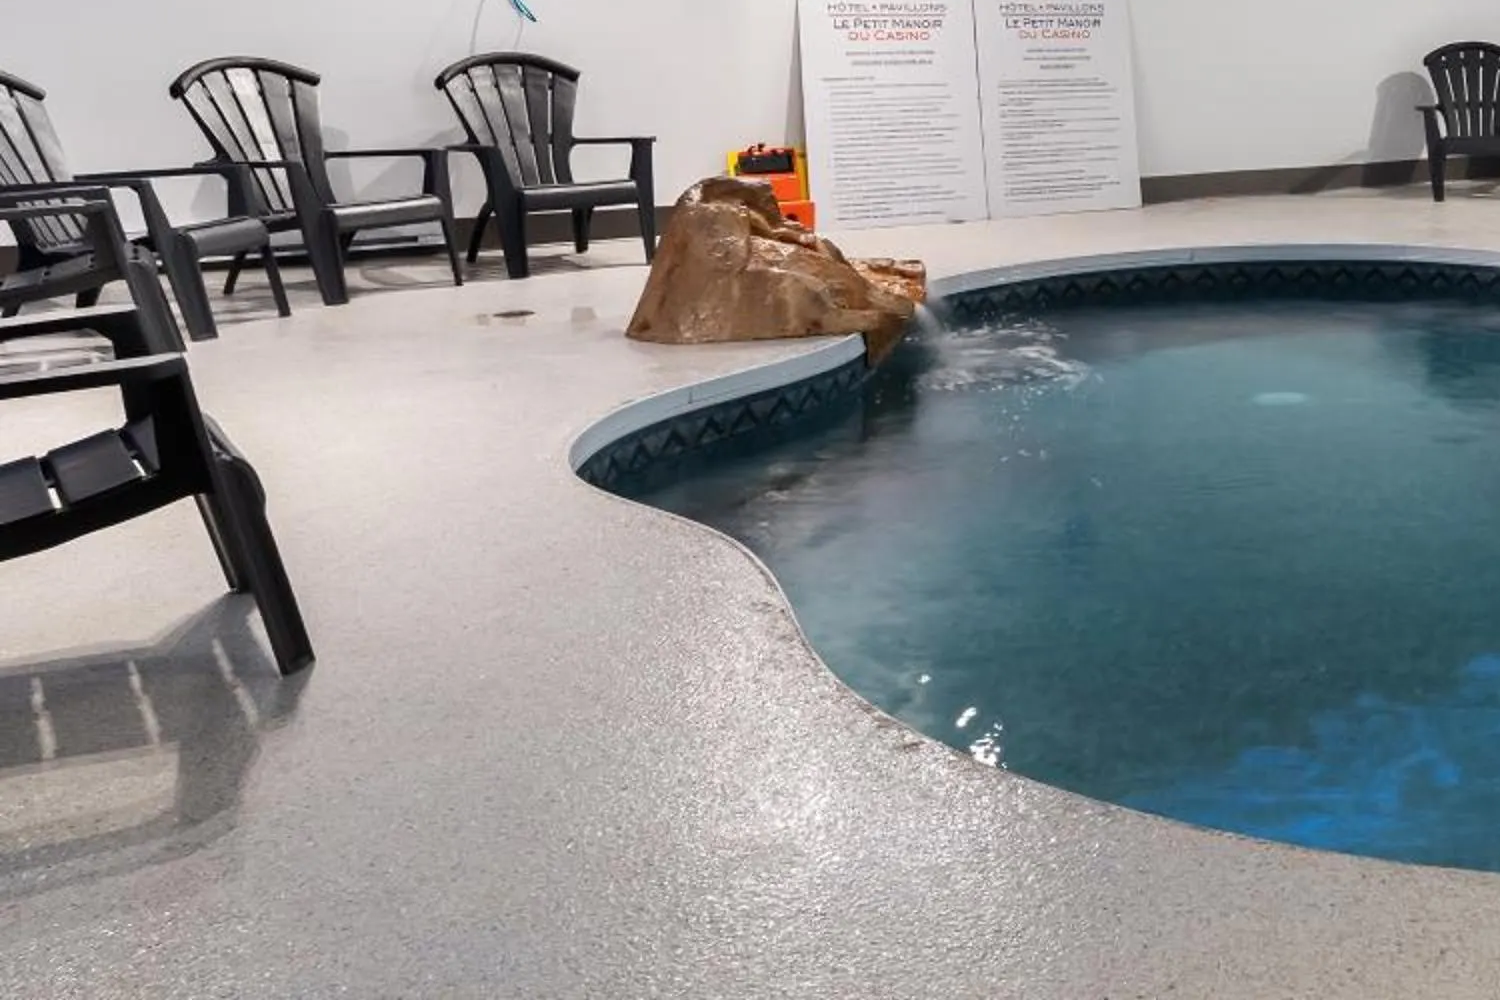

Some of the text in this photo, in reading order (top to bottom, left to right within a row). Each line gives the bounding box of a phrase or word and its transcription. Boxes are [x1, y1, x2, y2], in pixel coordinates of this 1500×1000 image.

[828, 2, 947, 13] HÔTEL PAVILLONS
[833, 18, 943, 29] LE PETIT MANOIR
[1023, 17, 1054, 29] PETIT
[1057, 18, 1102, 29] MANOIR
[847, 29, 931, 41] DU CASINO
[1041, 29, 1092, 39] CASINO
